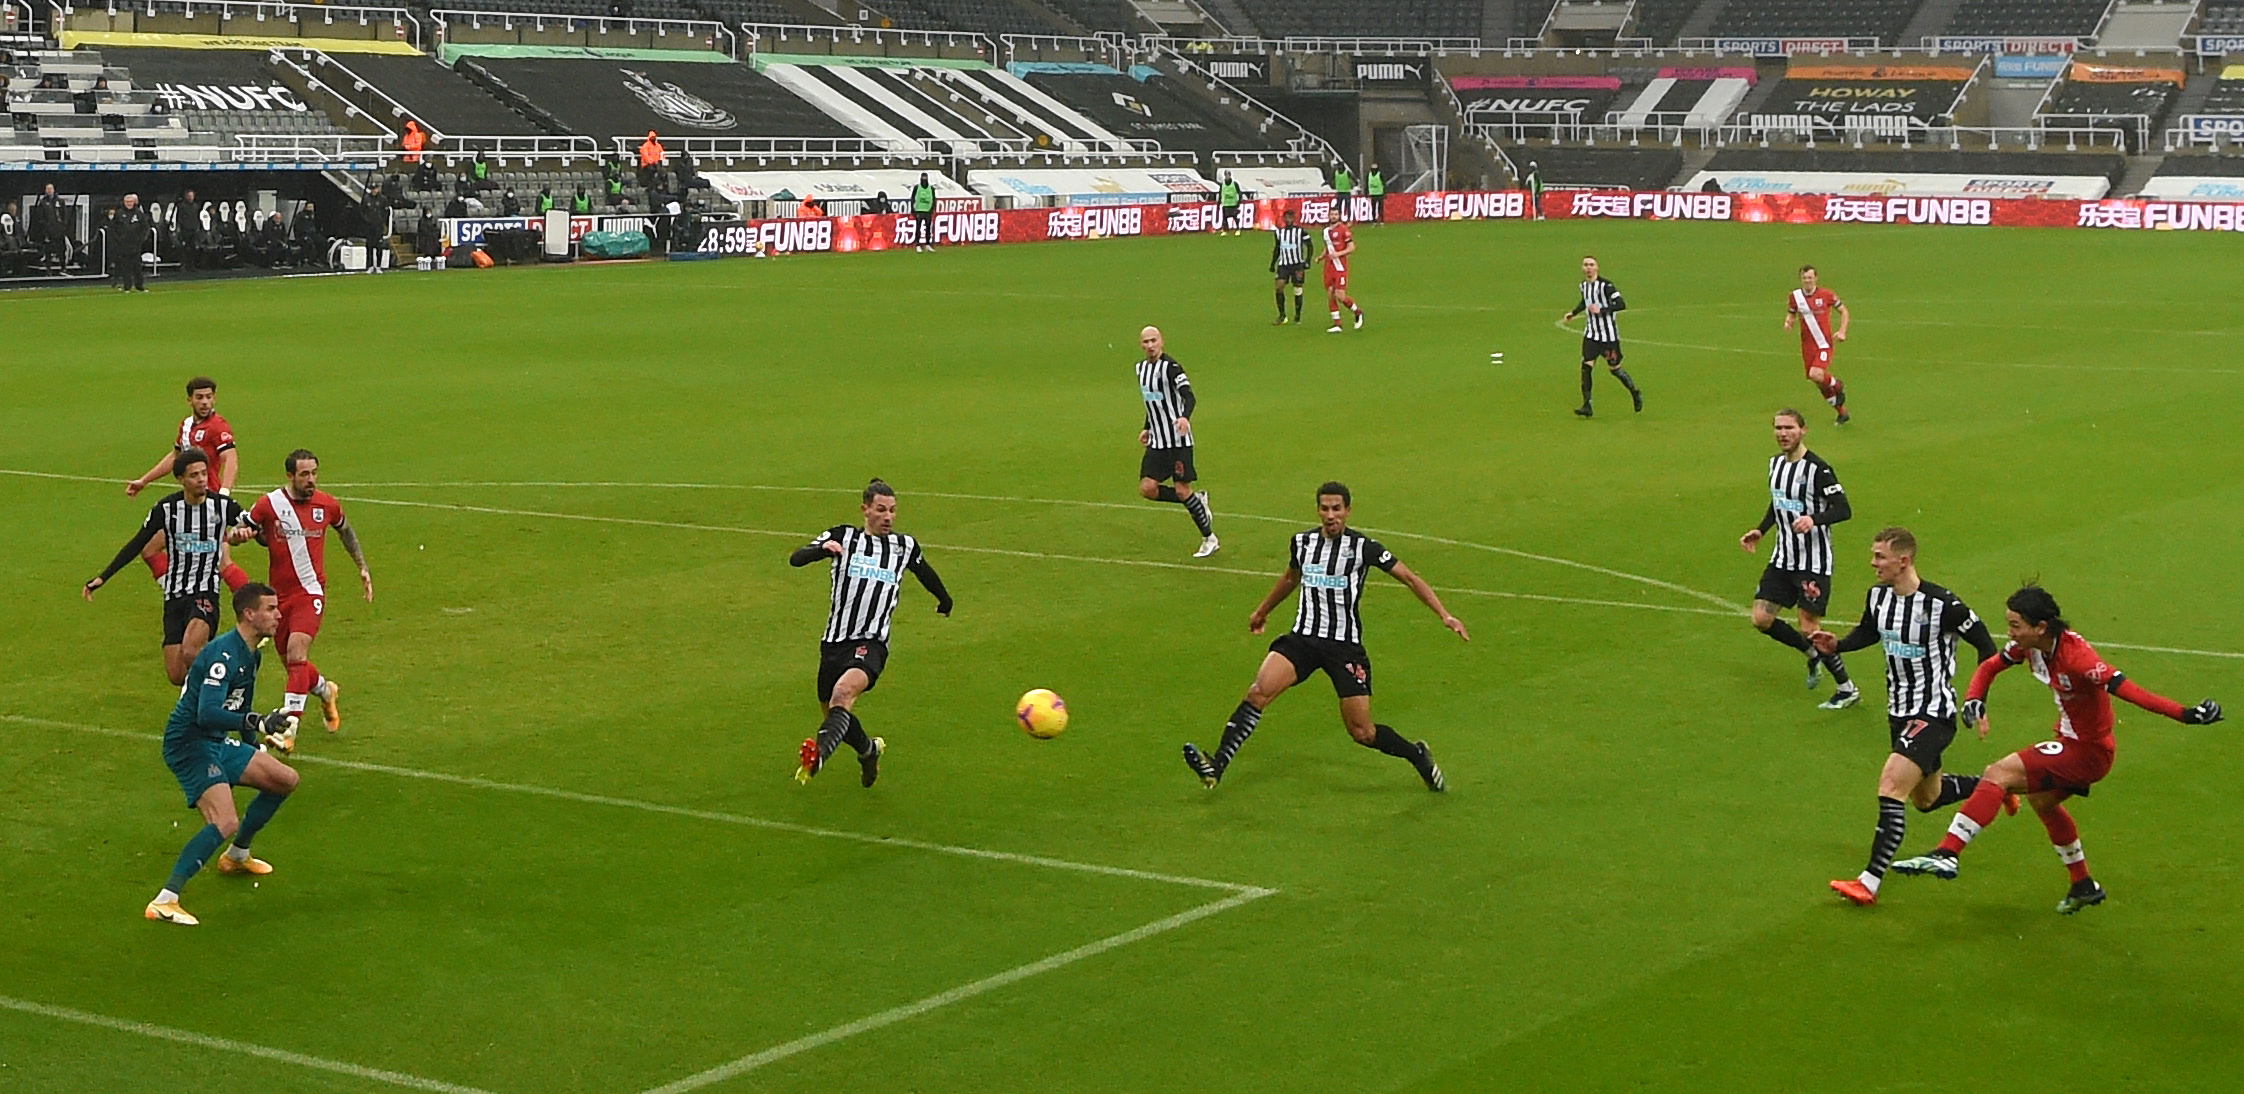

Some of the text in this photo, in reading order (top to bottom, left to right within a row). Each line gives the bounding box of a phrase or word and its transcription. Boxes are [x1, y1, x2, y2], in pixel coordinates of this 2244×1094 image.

[1722, 40, 1840, 53] SPORTS DIRECT
[1943, 40, 2067, 53] SPORTS DIRECT
[1209, 61, 1249, 78] PUMA
[1357, 63, 1404, 80] PUMA
[154, 82, 307, 112] #NUFC
[1809, 88, 1916, 98] HOWAY
[1467, 98, 1590, 112] #NUFC
[1795, 101, 1916, 112] THE LADS
[1751, 114, 1813, 135] PUMA
[1845, 114, 1908, 136] PUMA
[936, 200, 980, 213] DIRECT
[1444, 193, 1524, 217] FUN88
[1571, 193, 1631, 217] 乐天堂
[1634, 193, 1732, 220] FUN88
[1824, 198, 1884, 222] 乐天堂
[1886, 199, 1990, 224] FUN88
[1084, 208, 1142, 236] FUN88
[1201, 203, 1254, 231] FU8
[2077, 203, 2141, 229] 乐天堂
[532, 221, 589, 240] DCT
[760, 221, 832, 252] FUN88
[935, 213, 999, 242] FUN88
[313, 598, 323, 615] 9
[1901, 719, 1929, 739] 17
